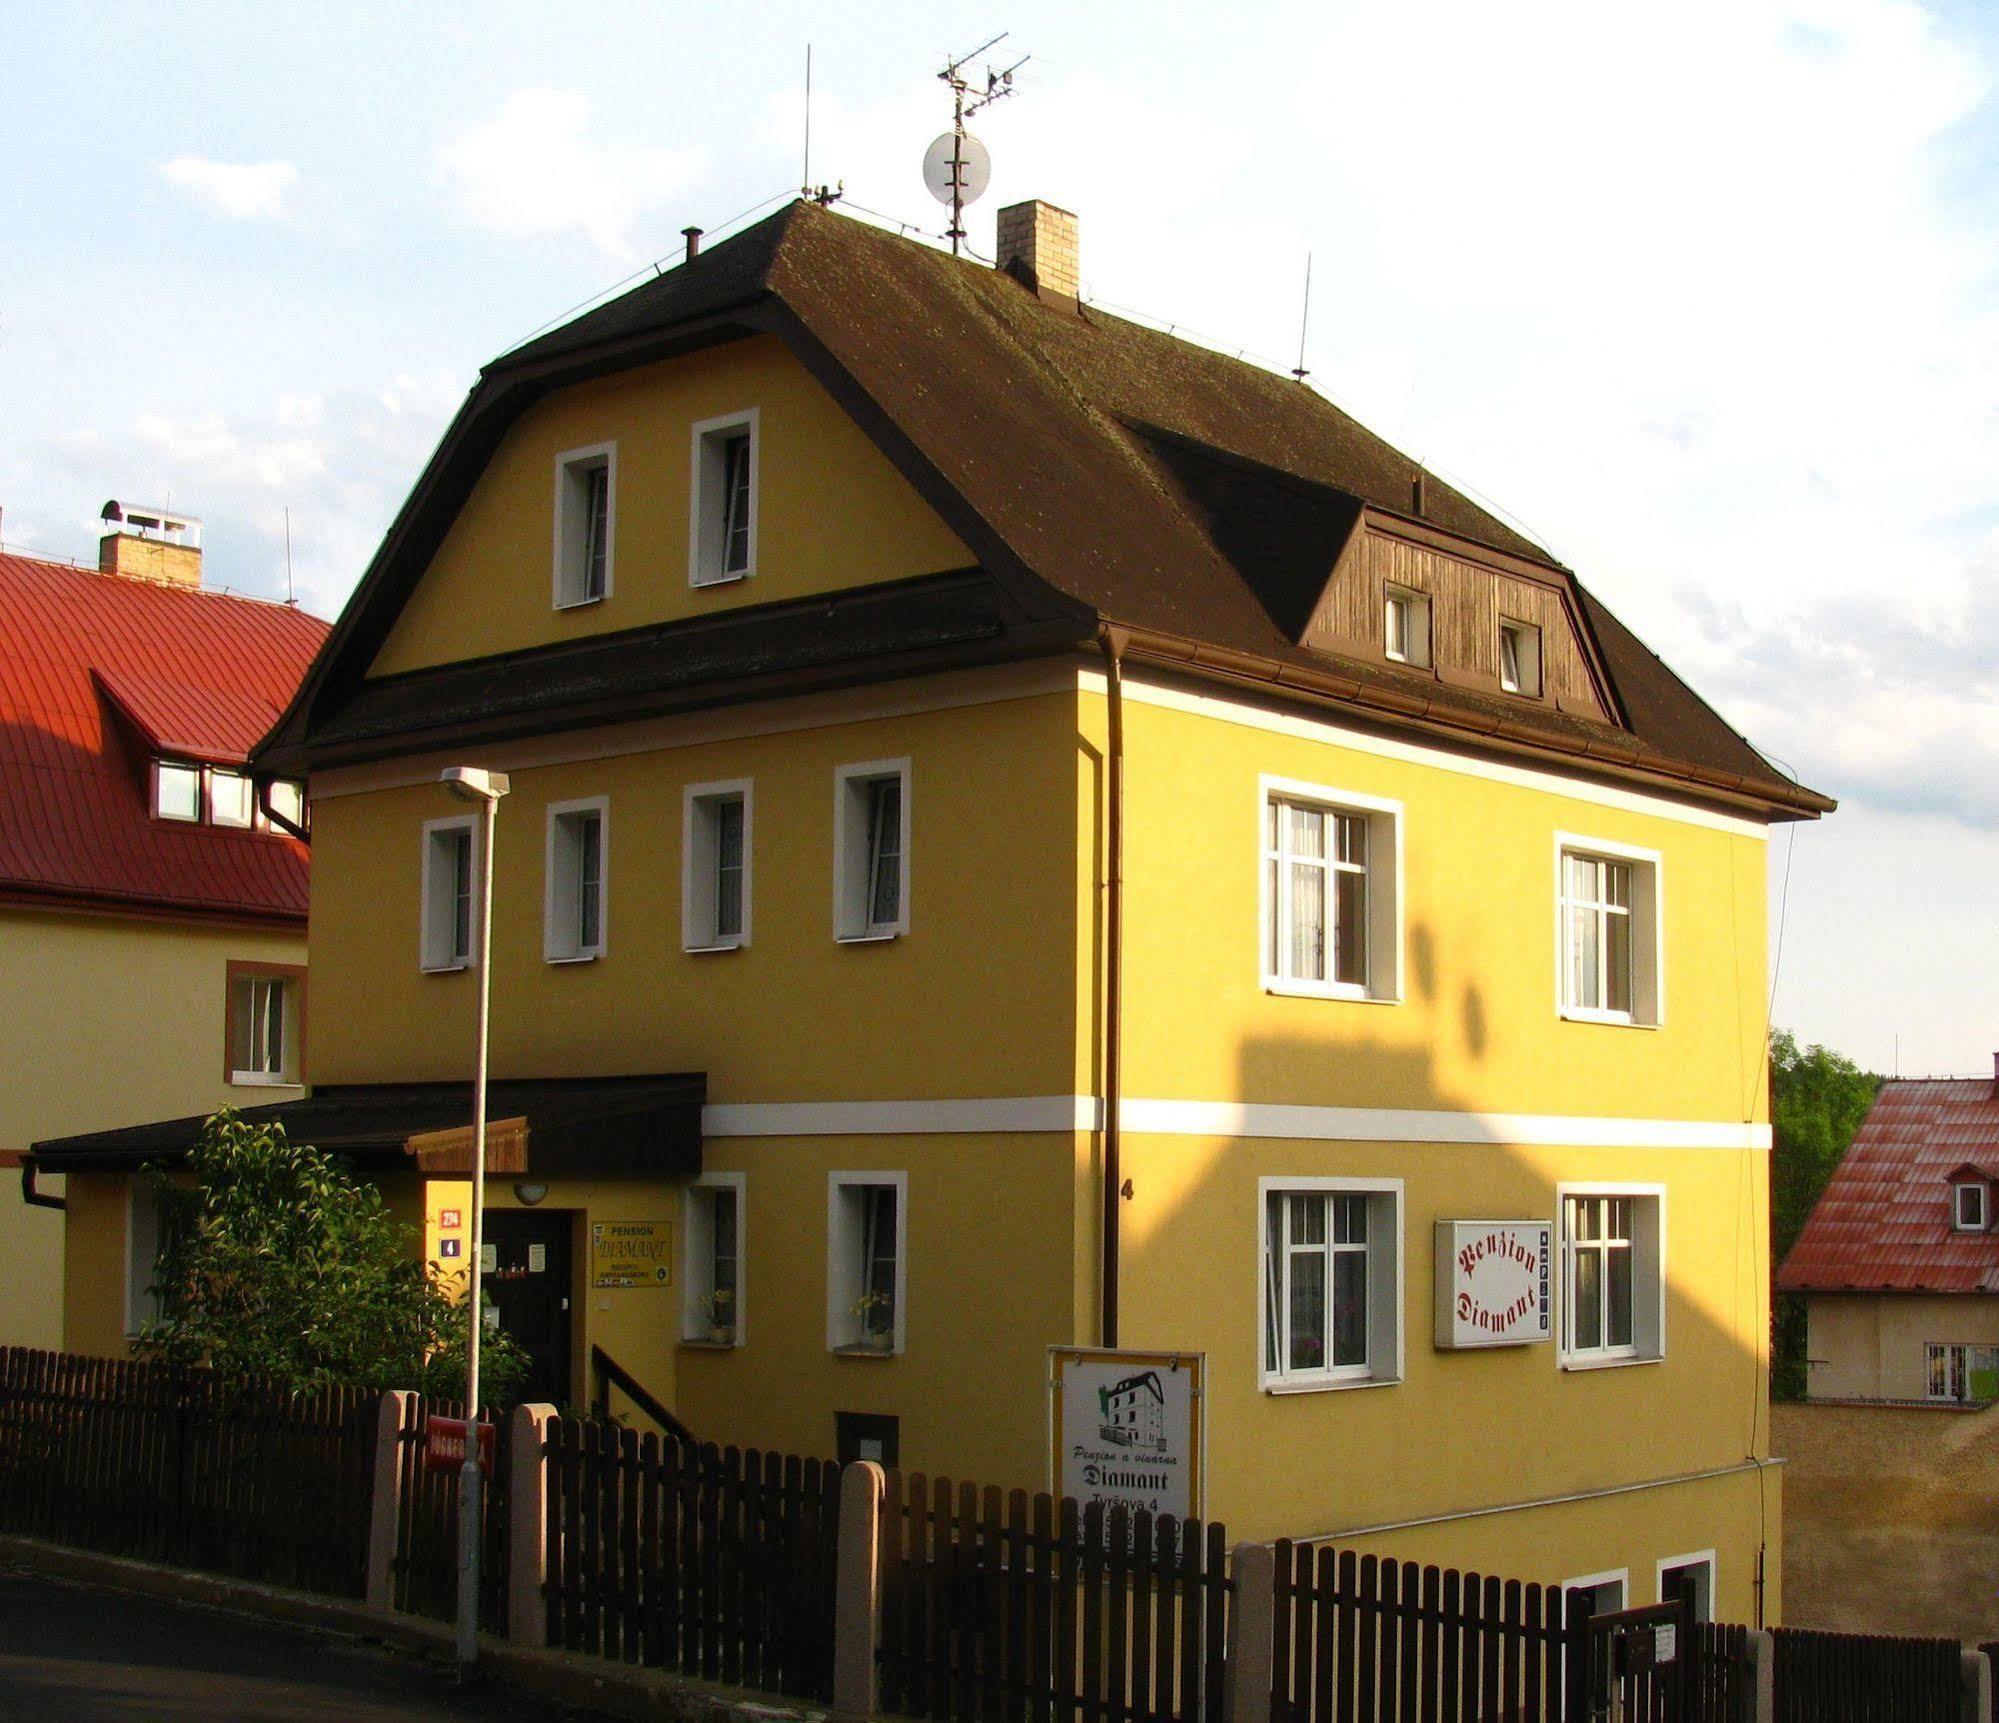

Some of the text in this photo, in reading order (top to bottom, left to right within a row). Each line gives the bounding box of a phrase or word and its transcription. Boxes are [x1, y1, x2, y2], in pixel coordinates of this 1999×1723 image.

[611, 1226, 654, 1236] PENSION
[446, 1240, 455, 1256] 4
[600, 1240, 665, 1262] DIAMANT
[1458, 1231, 1536, 1280] Penzion
[1457, 1284, 1535, 1333] Diamant
[1074, 1446, 1116, 1465] Penzion
[1122, 1452, 1129, 1462] a
[1083, 1465, 1168, 1490] Diamant
[1092, 1493, 1159, 1512] Tyršova 4
